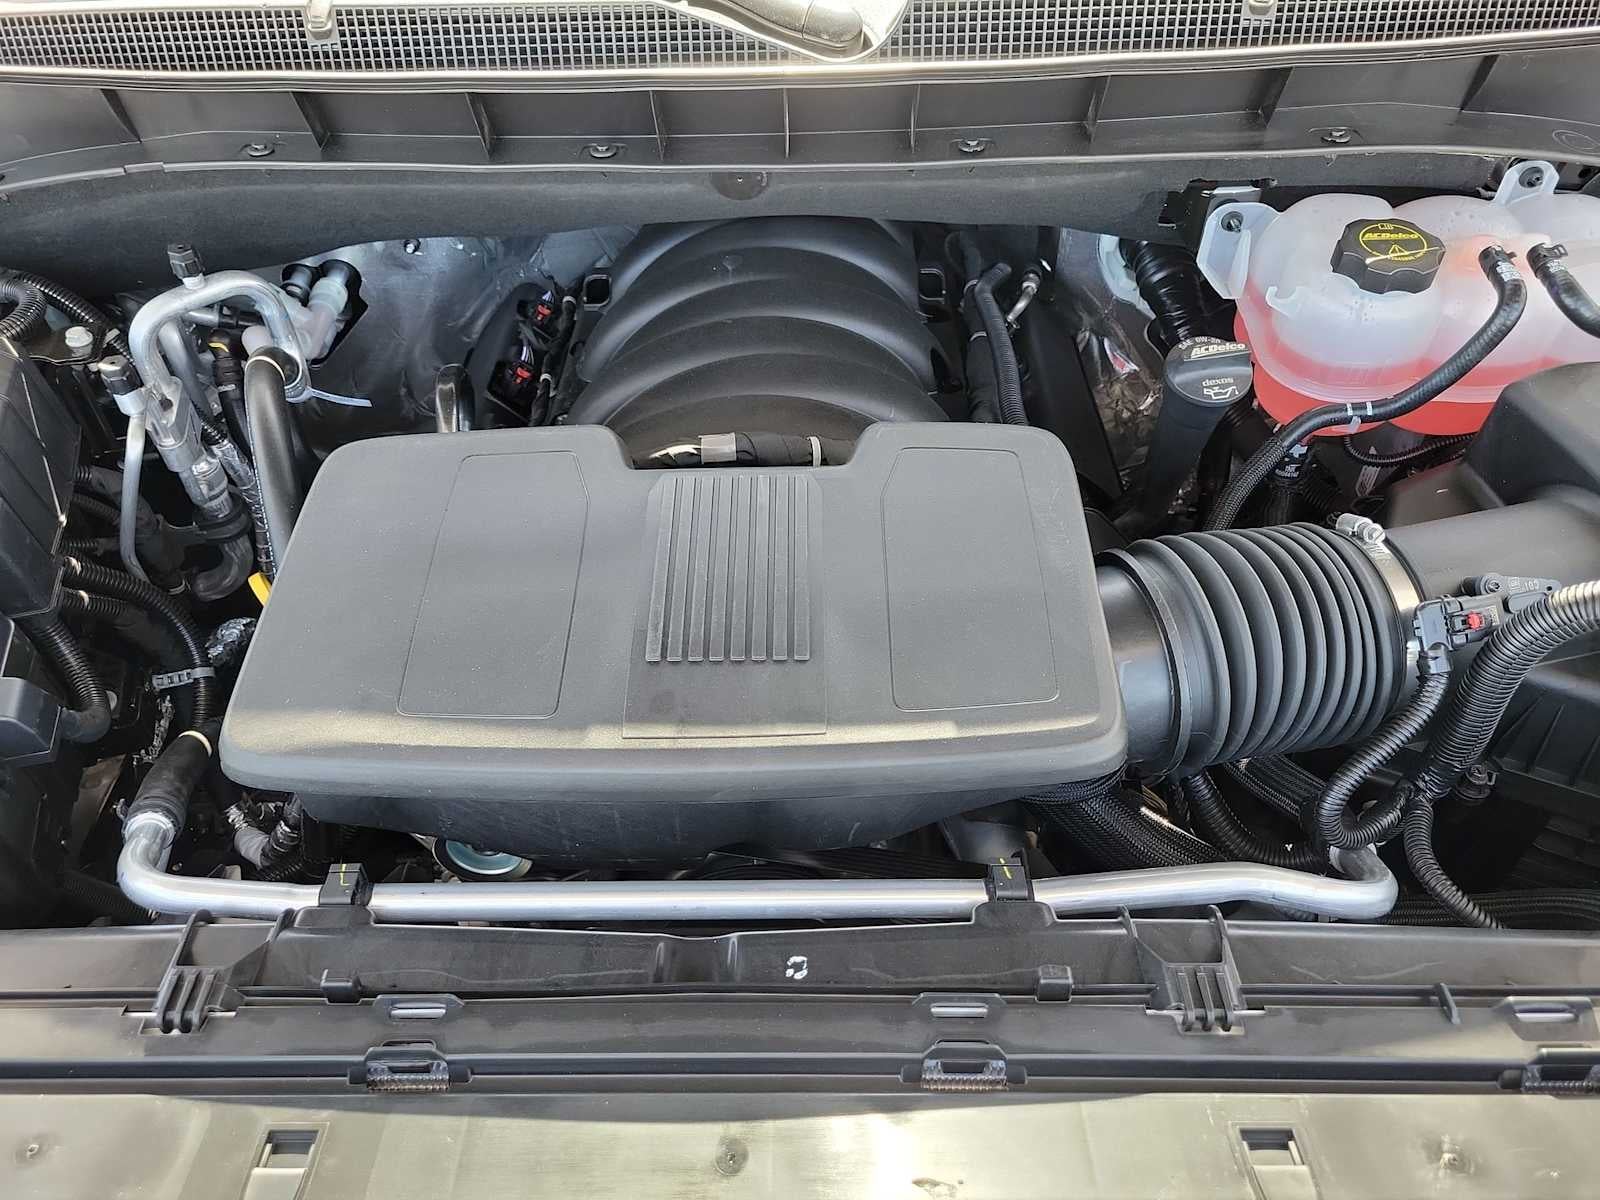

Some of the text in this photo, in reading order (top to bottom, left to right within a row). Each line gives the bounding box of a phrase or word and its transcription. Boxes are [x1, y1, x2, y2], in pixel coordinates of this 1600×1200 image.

[1363, 232, 1419, 240] ACDelco
[1191, 343, 1246, 357] ACDelco
[1202, 377, 1234, 386] dexos
